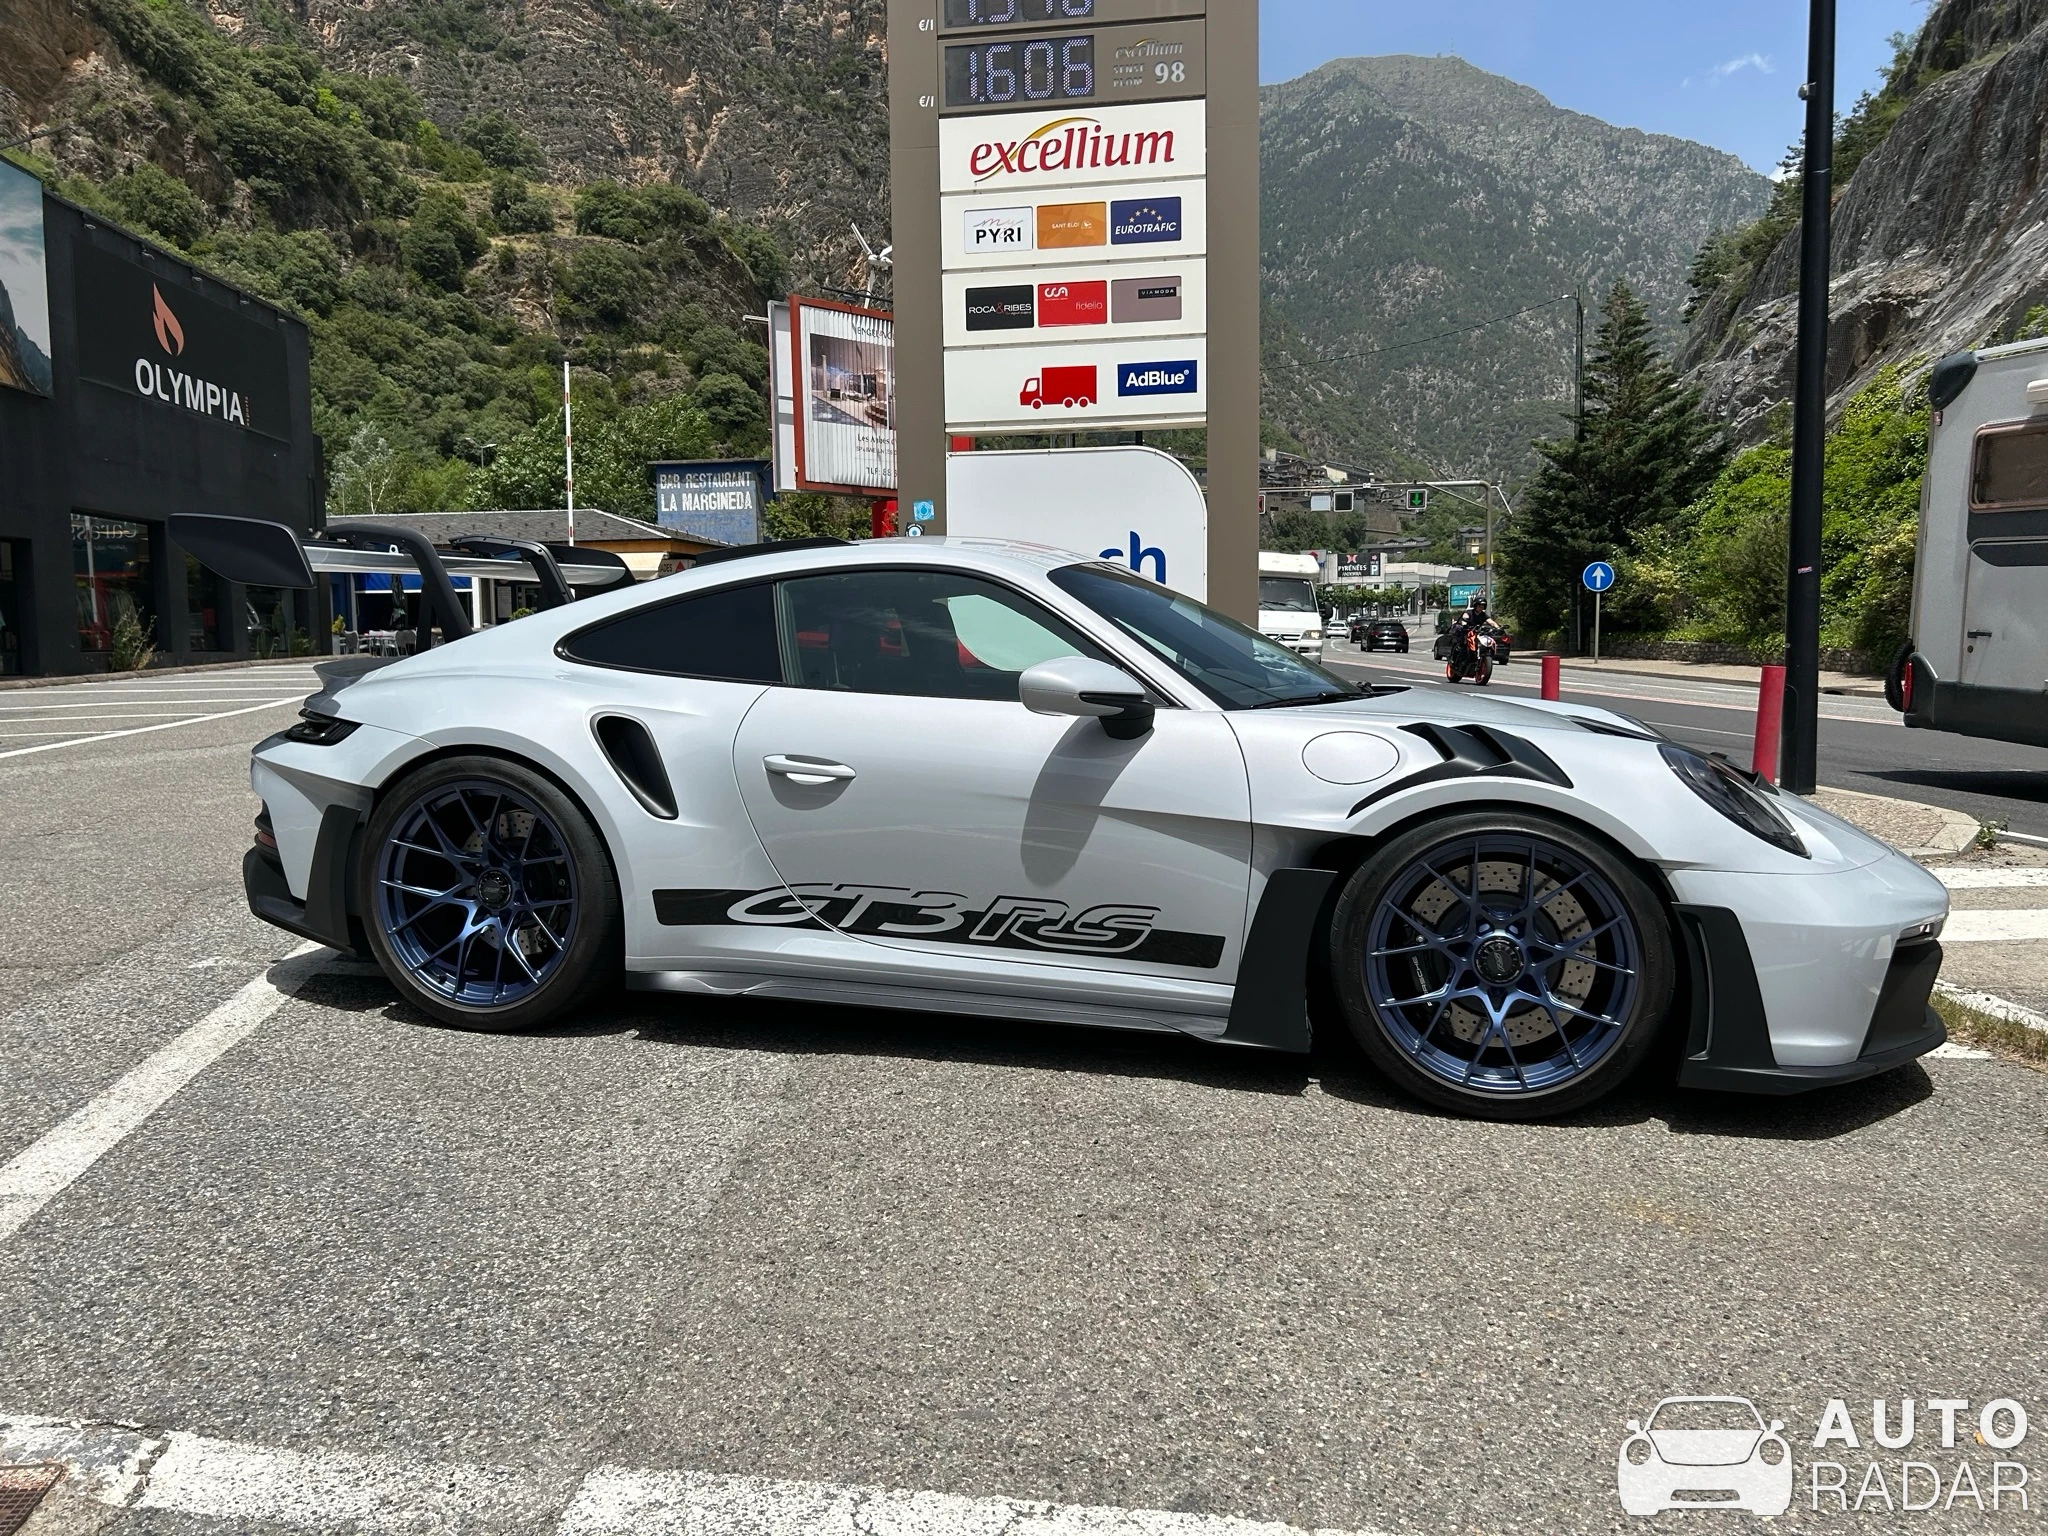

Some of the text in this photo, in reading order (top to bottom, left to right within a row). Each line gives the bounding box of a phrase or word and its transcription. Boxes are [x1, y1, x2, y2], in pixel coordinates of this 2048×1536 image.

[1115, 40, 1184, 59] excellium
[969, 38, 1093, 101] 1.606
[1154, 60, 1185, 84] 98
[1113, 76, 1143, 87] PLOM
[970, 124, 1174, 176] excellium
[976, 226, 1021, 244] PYRI
[1115, 222, 1177, 235] EUROTRAFIC
[135, 358, 245, 426] OLYMPIA
[660, 471, 752, 489] BAR RESTAURANT
[661, 491, 753, 512] LA MARGINEDA
[1371, 565, 1379, 576] P
